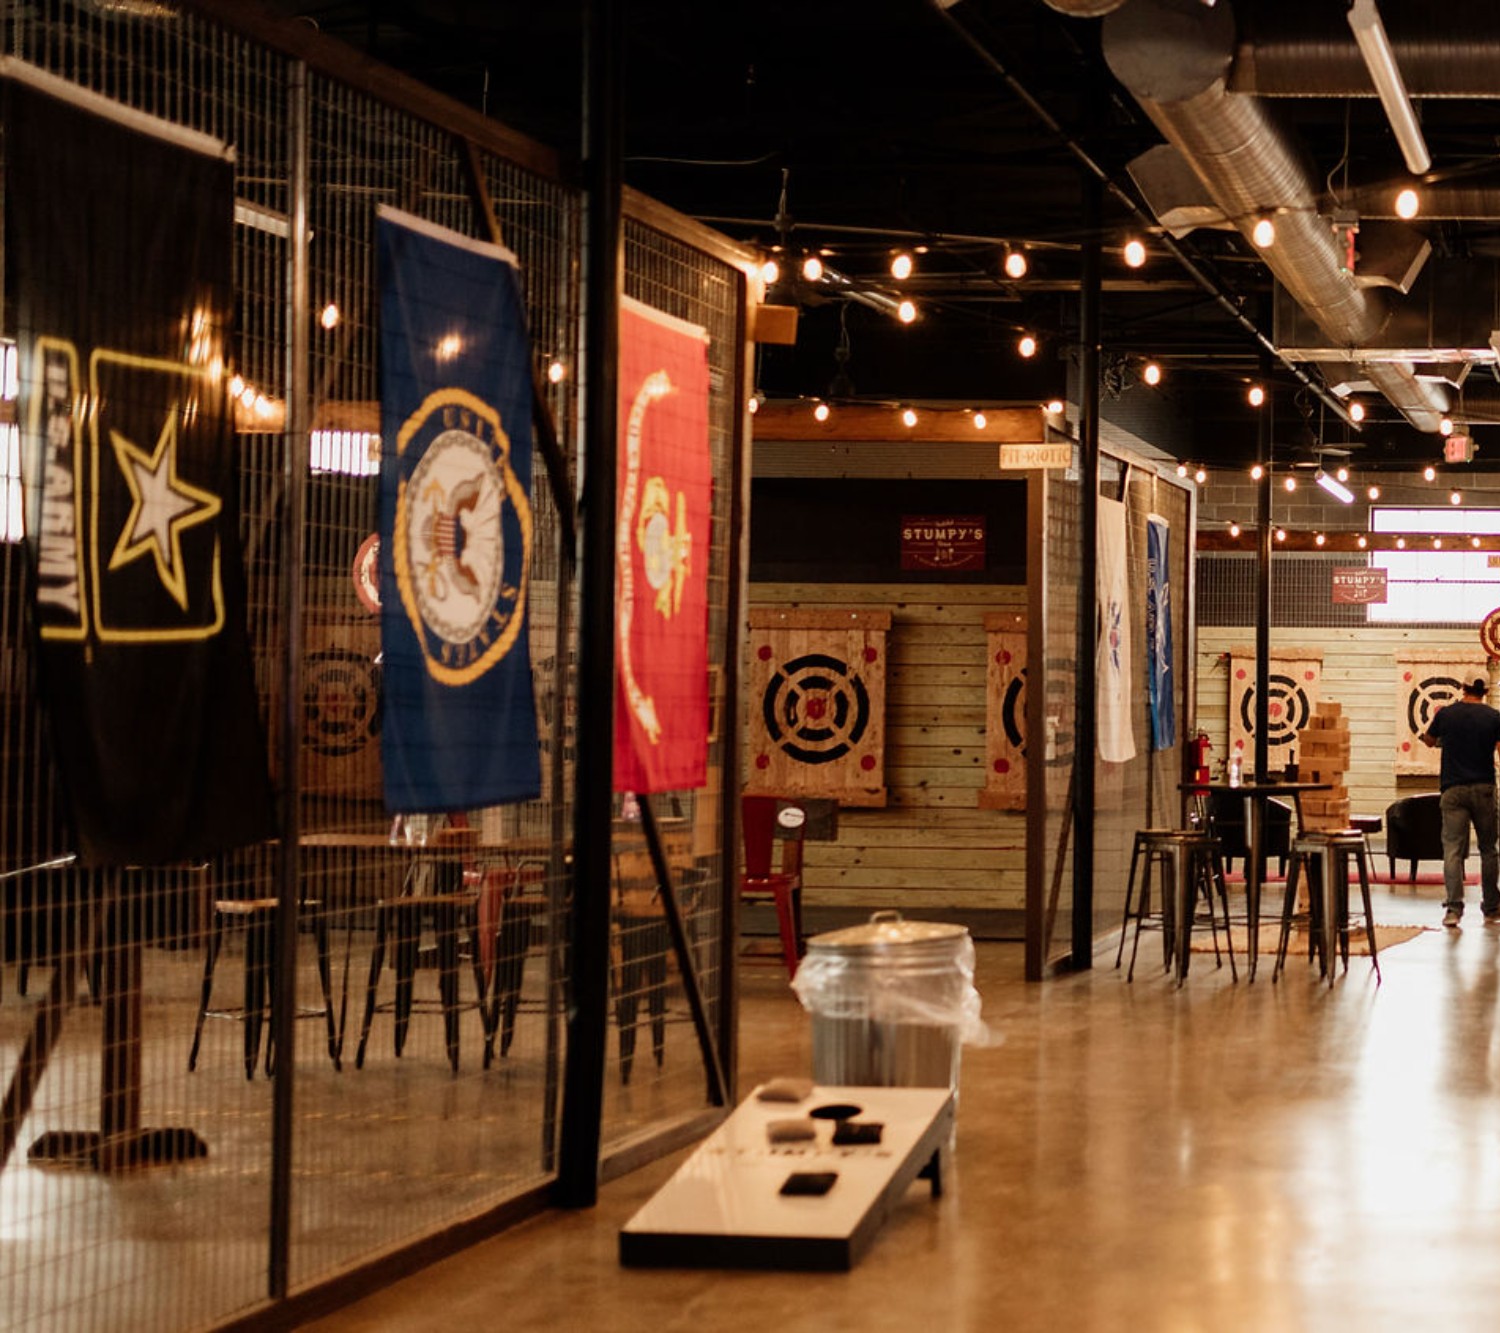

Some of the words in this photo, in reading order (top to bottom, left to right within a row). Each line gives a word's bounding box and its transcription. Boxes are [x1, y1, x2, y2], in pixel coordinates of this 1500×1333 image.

[37, 463, 80, 614] ARMY
[903, 528, 983, 540] STUMPY'S
[1333, 576, 1386, 584] STUMPY'S
